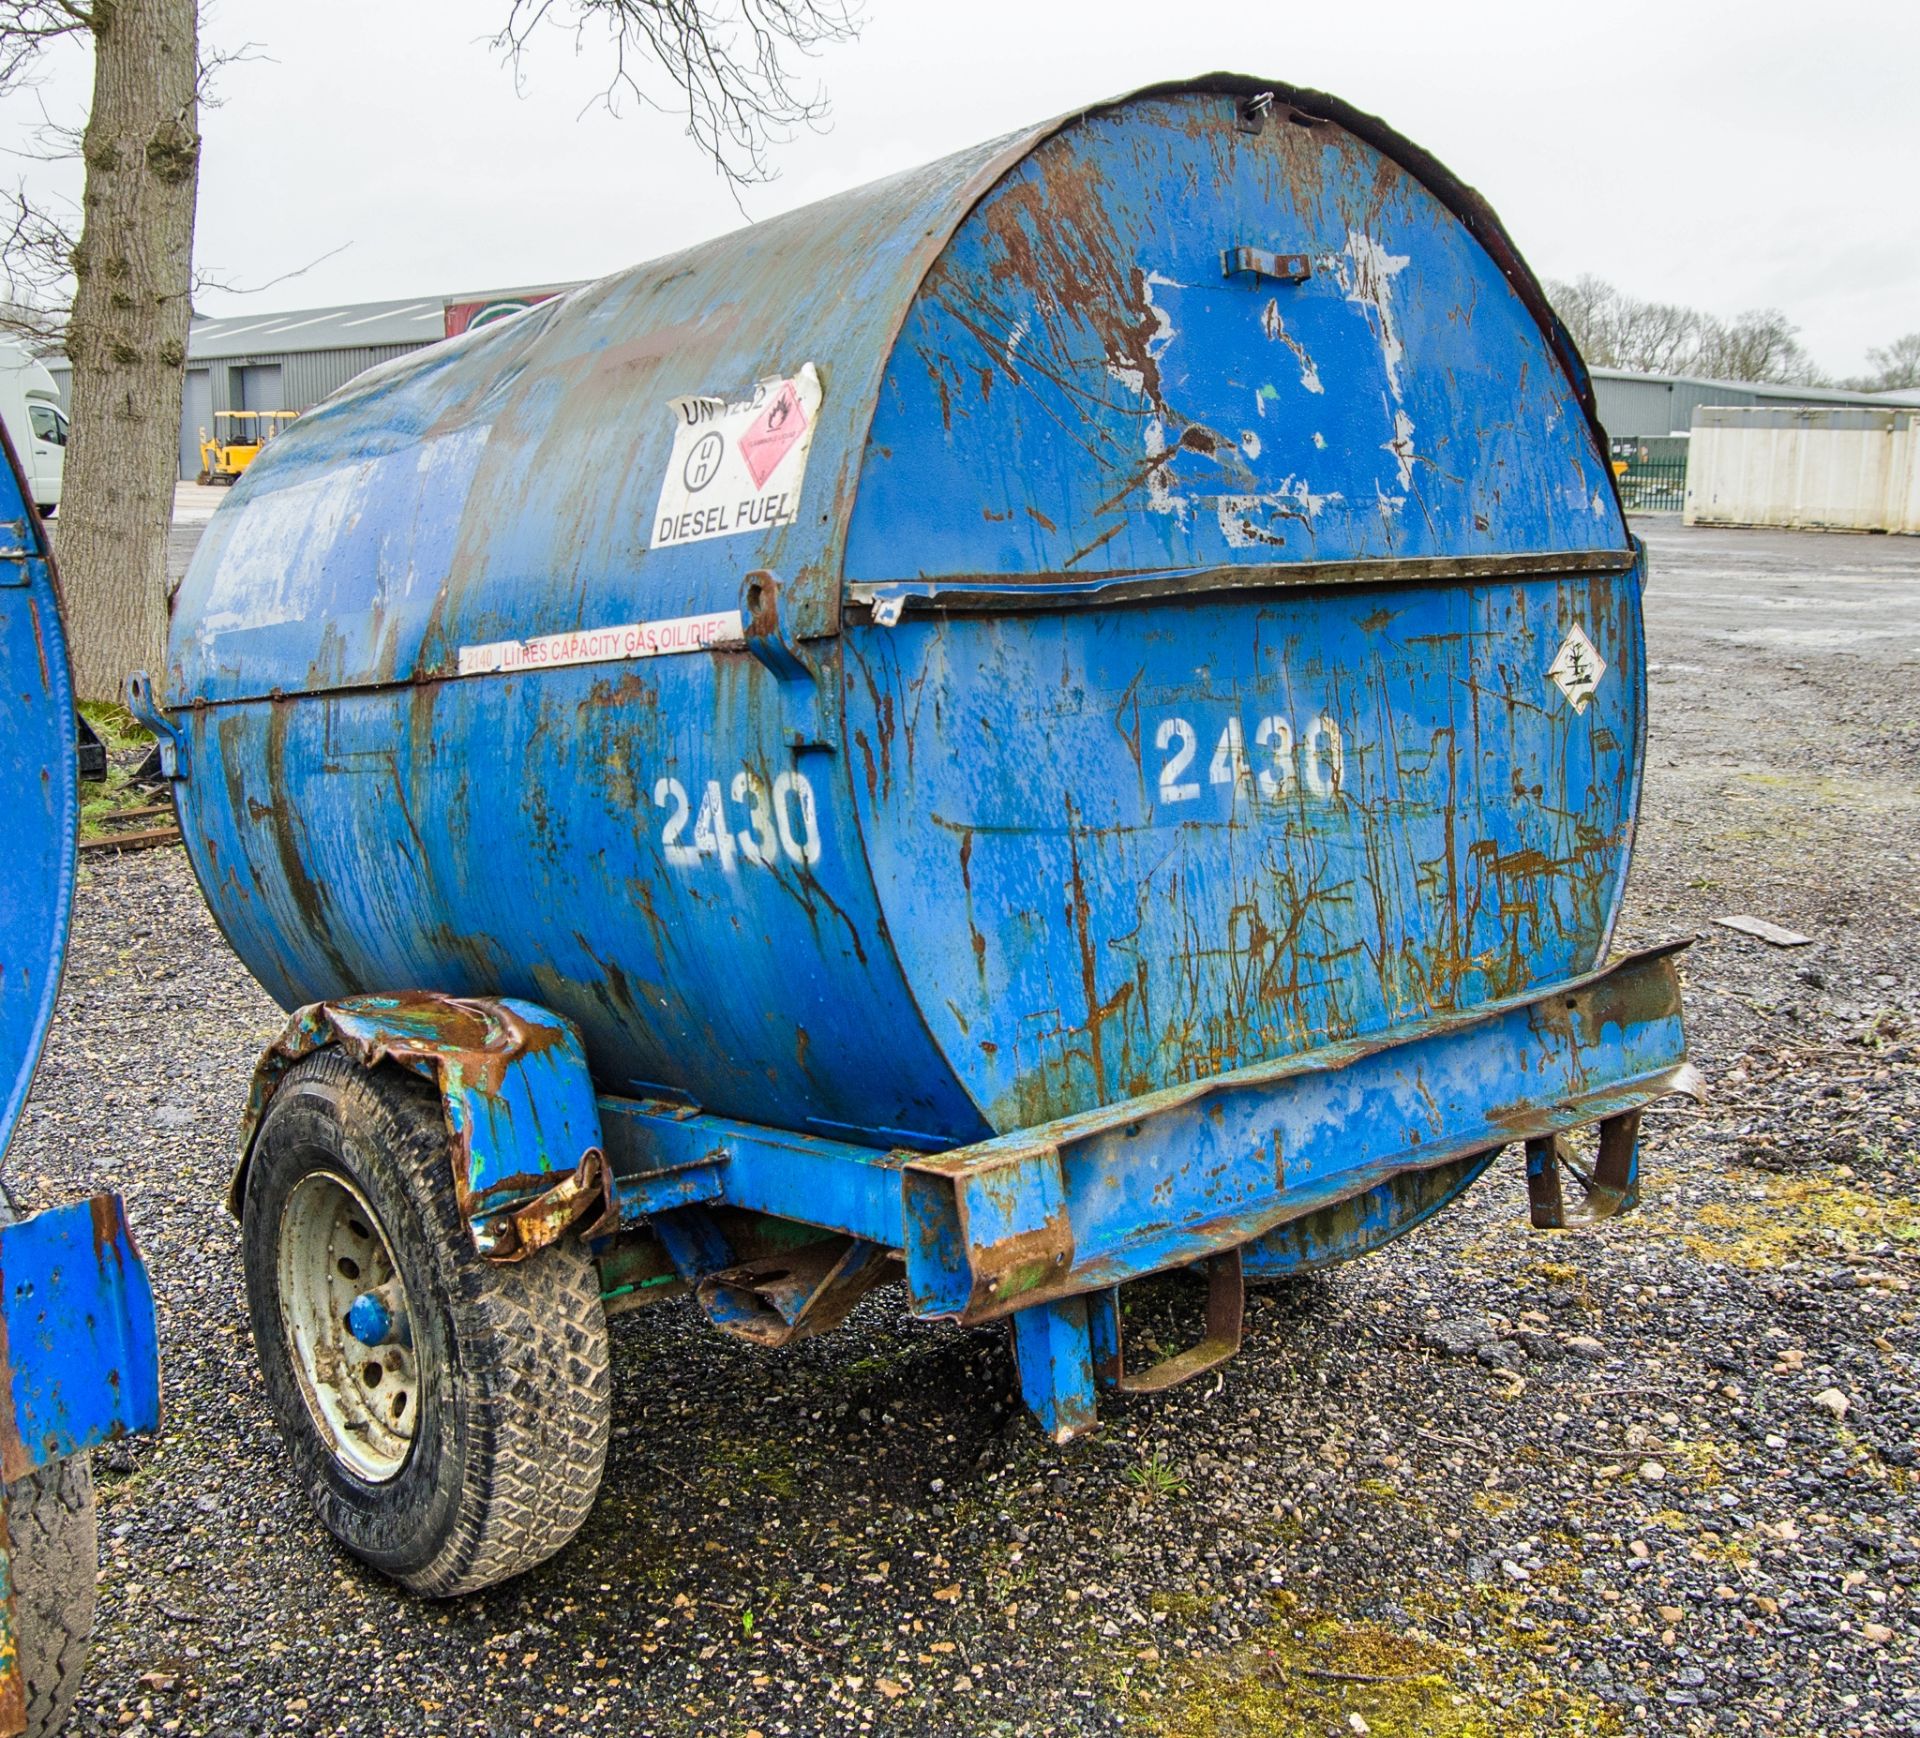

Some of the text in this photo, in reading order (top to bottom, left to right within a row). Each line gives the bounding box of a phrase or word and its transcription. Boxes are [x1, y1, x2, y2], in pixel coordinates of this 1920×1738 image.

[682, 400, 715, 426] UN
[659, 493, 790, 543] DIESEL FUEL
[467, 648, 493, 671] 2140
[551, 633, 621, 661] CAPACITY
[625, 627, 656, 652] GAS
[1155, 715, 1345, 804] 2430
[654, 772, 822, 873] 2430
